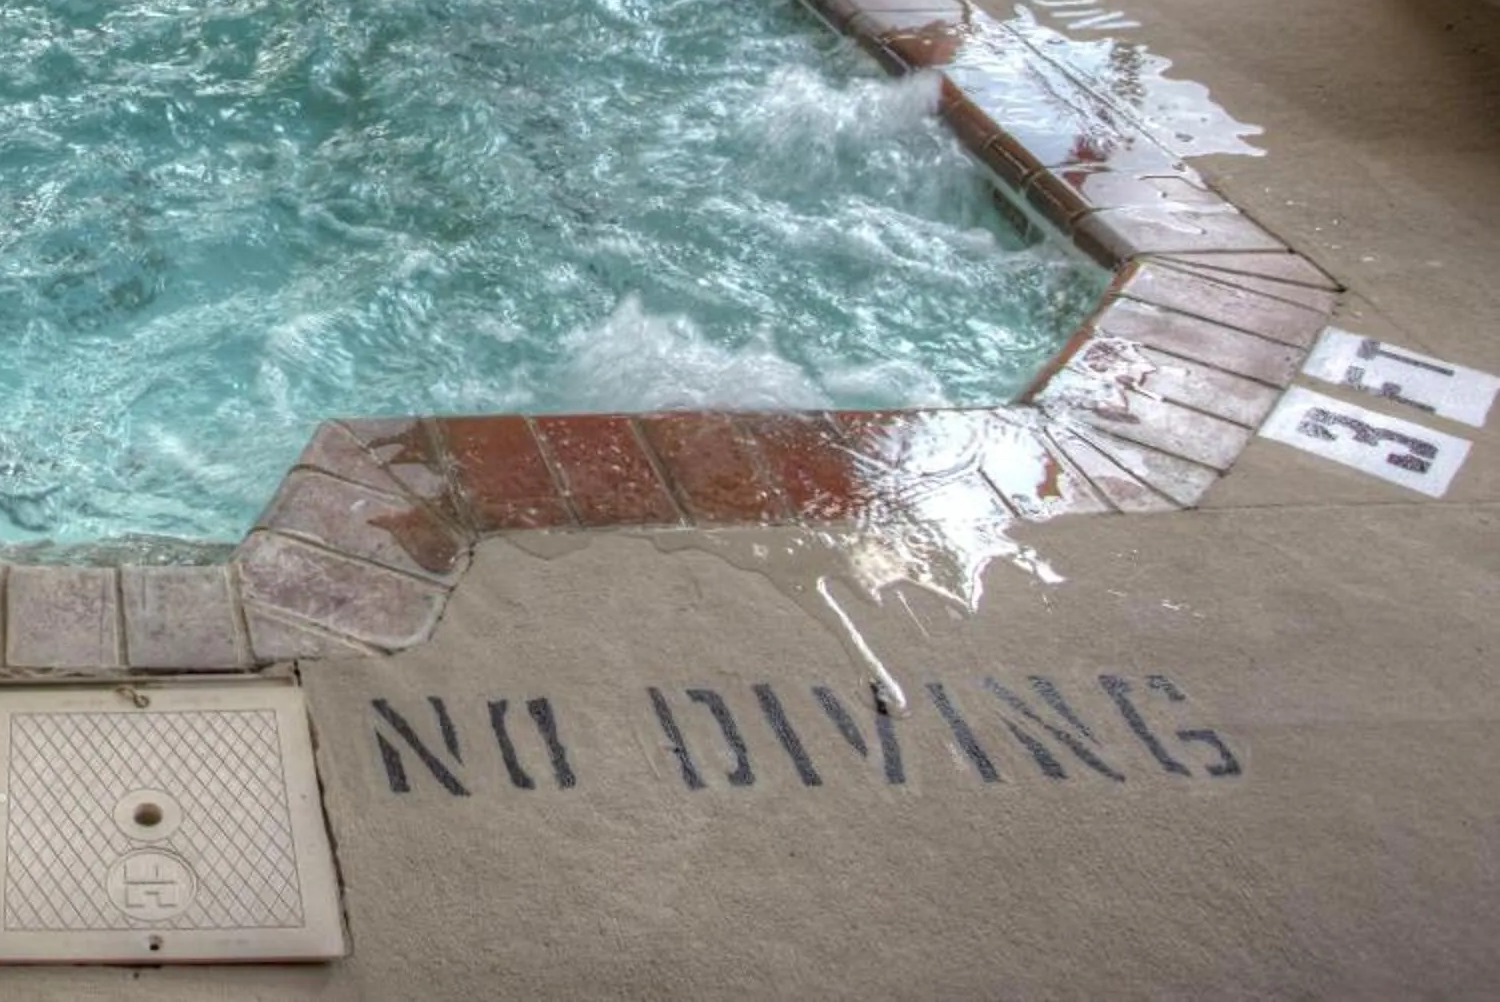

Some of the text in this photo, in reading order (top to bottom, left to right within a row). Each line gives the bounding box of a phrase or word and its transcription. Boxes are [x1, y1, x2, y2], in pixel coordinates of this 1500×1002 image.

[1298, 406, 1440, 474] 3
[371, 674, 1242, 796] NO DIVING
